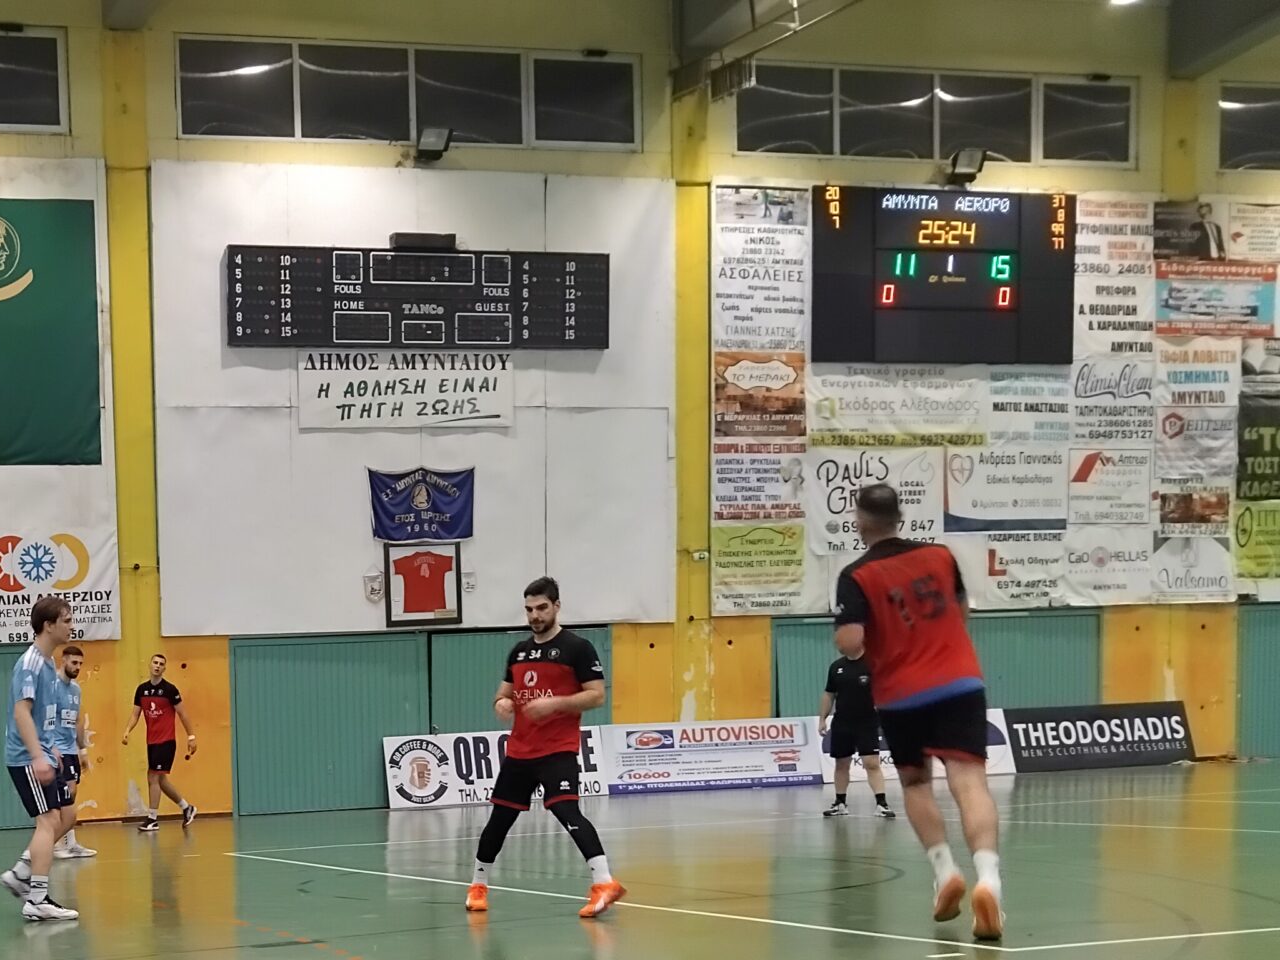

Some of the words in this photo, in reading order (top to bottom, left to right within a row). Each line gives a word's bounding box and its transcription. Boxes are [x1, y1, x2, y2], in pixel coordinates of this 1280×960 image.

[826, 186, 839, 200] 20
[882, 194, 938, 210] AMYNTA
[918, 220, 976, 244] 25:24
[1052, 223, 1064, 235] 99
[235, 254, 242, 265] 4
[280, 255, 291, 265] 10
[896, 253, 915, 276] 11
[947, 255, 954, 272] 1
[991, 255, 1010, 278] 15
[1074, 263, 1110, 273] 23860
[1118, 264, 1152, 274] 24081
[235, 268, 242, 279] 5
[280, 270, 291, 280] 11
[719, 267, 804, 283] ΑΣΦΑΛΕΙΕΣ
[236, 283, 242, 294] 6
[280, 284, 291, 295] 12
[334, 286, 362, 294] FOULS
[483, 288, 510, 296] FOULS
[882, 284, 894, 303] 0
[1095, 286, 1136, 296] ΠΡΟΣΦΟΡΑ
[999, 287, 1010, 305] 0
[236, 298, 242, 308] 7
[280, 298, 291, 309] 13
[334, 301, 364, 310] HOME
[475, 303, 510, 312] GUEST
[1089, 304, 1137, 315] ΘΕΟΔΩΡΙΔΗ
[236, 312, 242, 323] 8
[280, 312, 291, 323] 14
[236, 326, 243, 337] 9
[280, 326, 291, 337] 15
[726, 325, 761, 336] ΓΙΑΝΝΗΣ
[765, 327, 795, 337] ΧΑΤΖΗΣ
[1097, 321, 1153, 331] ΧΑΡΑΛΑΜΠΙΔΗ
[1111, 342, 1153, 352] ΑΜΥΝΤΑΙΟ
[304, 353, 379, 370] ΔΗΜΟΣ
[388, 352, 511, 371] ΑΜΥΝΤΑΙΟΥ
[846, 366, 890, 375] Τεχνικό
[895, 366, 945, 377] γραφείο
[318, 383, 329, 399] Η
[344, 378, 426, 398] ΑΘΛΗΣΗ
[439, 377, 498, 394] ΕΙΝΑΙ
[337, 403, 403, 420] ΠΗΓΗ
[416, 398, 481, 416] ΖΩΗΣ
[1089, 430, 1153, 439] 6948753127
[979, 452, 1016, 466] Ανδρέας
[1020, 451, 1062, 465] Γιαννακός
[395, 514, 415, 523] ΕΤΟΣ
[407, 523, 436, 532] 1960
[911, 520, 934, 531] 847
[1109, 550, 1148, 562] HELLAS
[997, 580, 1021, 589] 6974
[1158, 568, 1228, 590] Valsamo
[8, 632, 28, 642] 699
[529, 650, 541, 659] 34
[679, 725, 794, 743] AUTOVISION
[1013, 716, 1185, 747] THEODOSIADIS
[399, 741, 421, 754] COFFEE
[428, 743, 444, 759] MORE
[1056, 746, 1108, 755] CLOTHING
[1120, 741, 1188, 751] ACCESSORIES
[454, 736, 493, 785] QR
